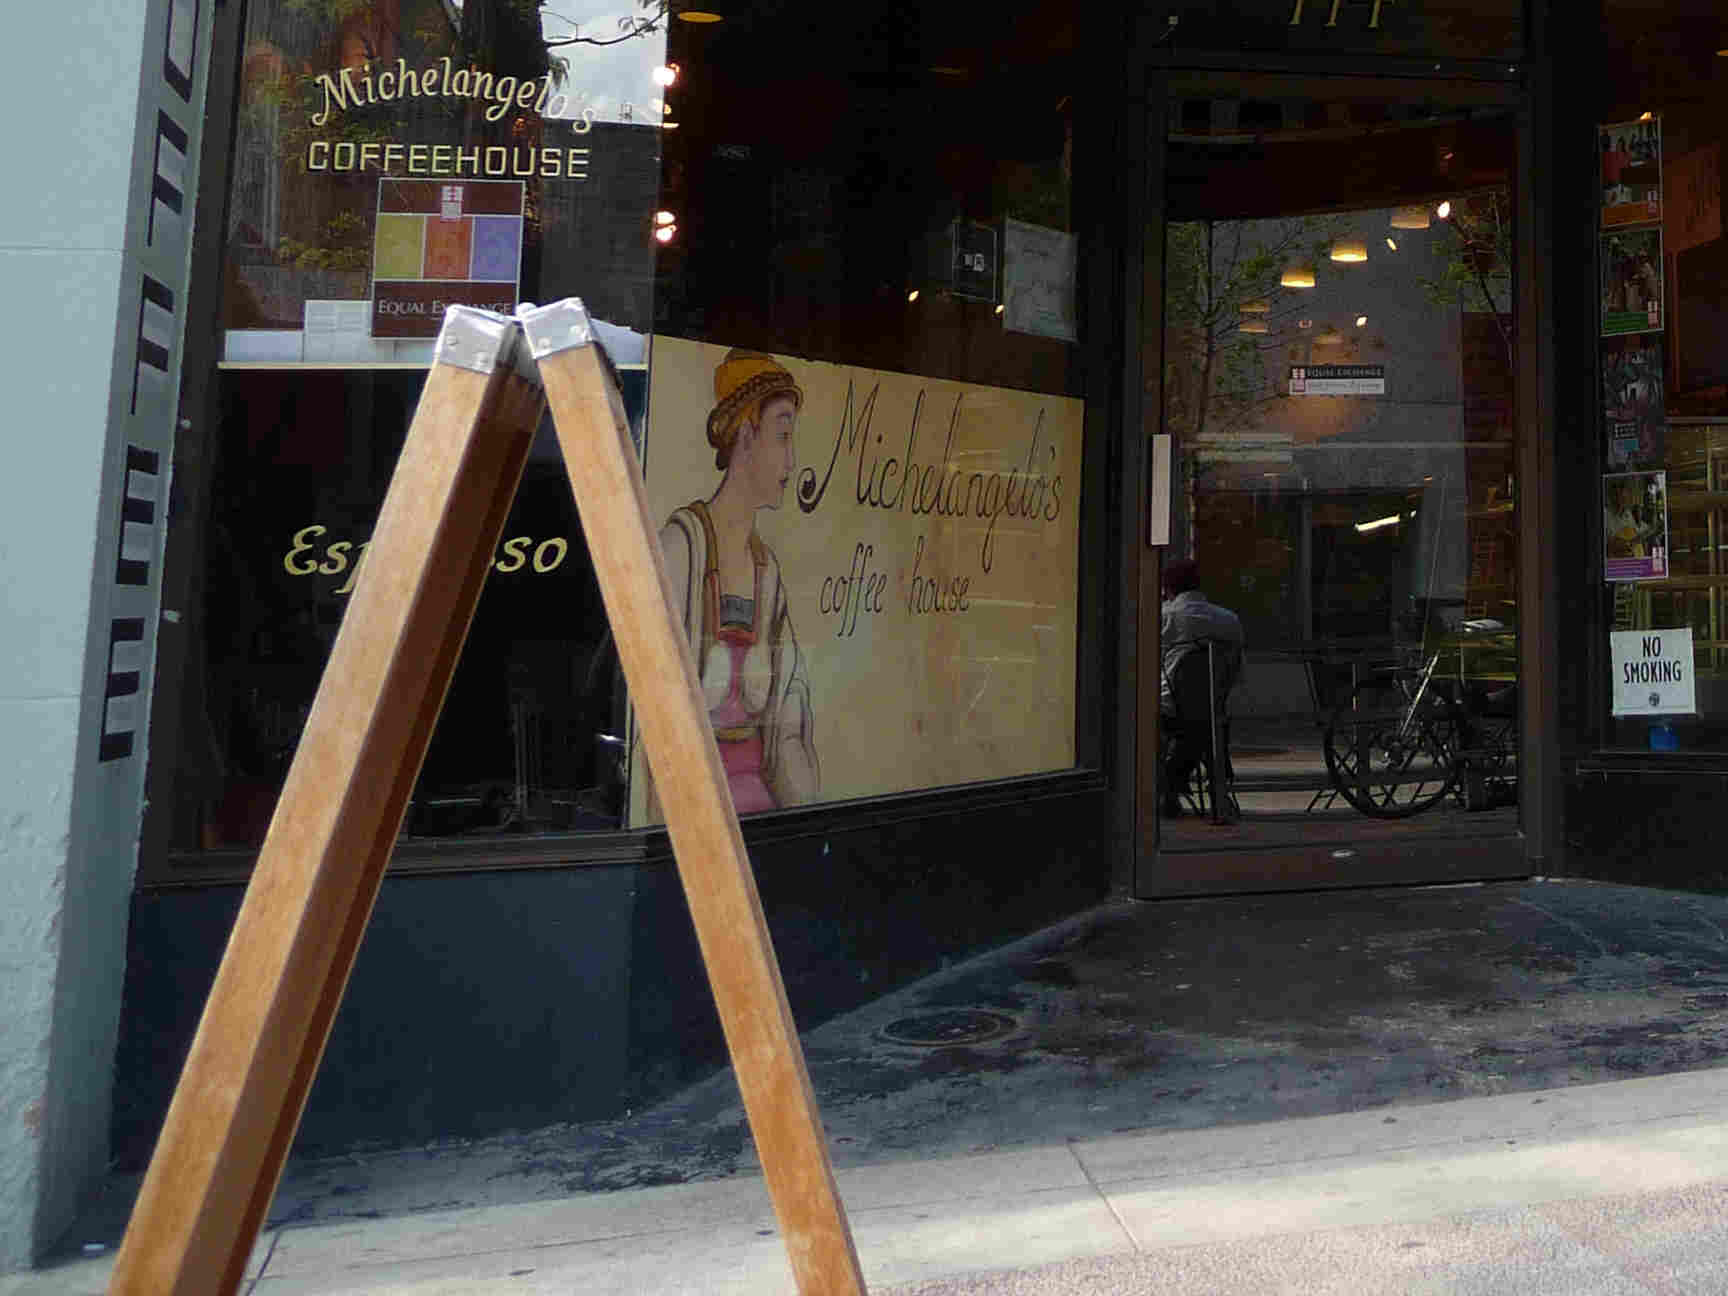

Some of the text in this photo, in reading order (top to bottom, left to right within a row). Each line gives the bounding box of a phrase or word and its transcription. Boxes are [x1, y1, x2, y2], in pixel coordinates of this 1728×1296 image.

[308, 141, 591, 179] COFFEEHOUSE
[796, 376, 1065, 574] Michelangelo's
[819, 535, 970, 638] coffee house
[1642, 636, 1661, 658] NO
[1623, 660, 1682, 684] SMOKING
